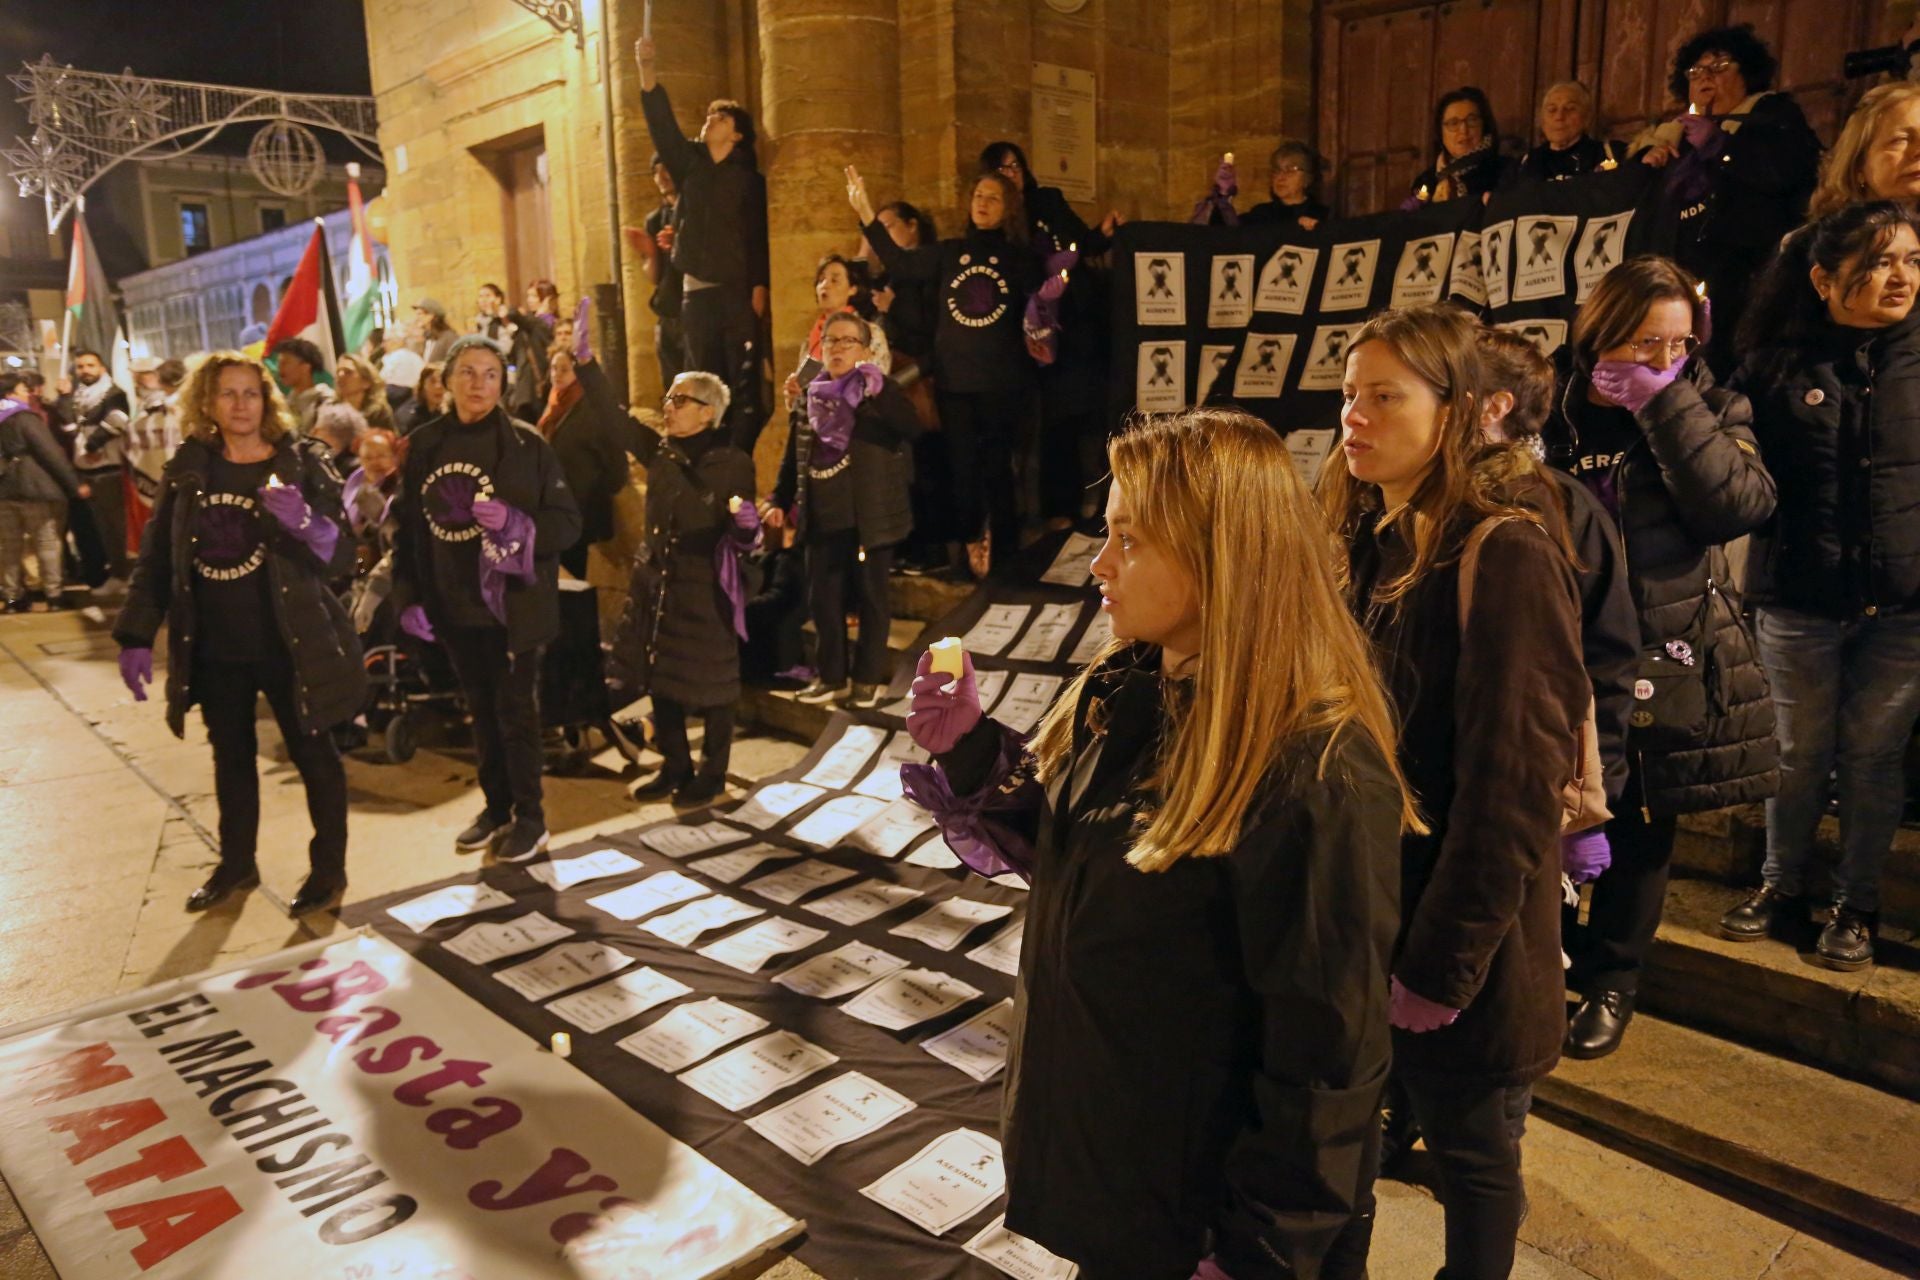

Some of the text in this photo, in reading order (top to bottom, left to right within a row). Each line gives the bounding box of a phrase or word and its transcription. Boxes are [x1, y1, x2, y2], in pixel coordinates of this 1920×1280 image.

[950, 265, 1009, 294] MUYERES DE
[951, 304, 1007, 328] ESCANDALERA
[127, 993, 219, 1039] EL
[234, 959, 523, 1150] ¡Basta
[824, 1094, 867, 1122] ASESINADA
[157, 1029, 418, 1245] MACHISMO
[18, 1041, 244, 1272] MATA
[936, 1158, 988, 1189] ASESINADA
